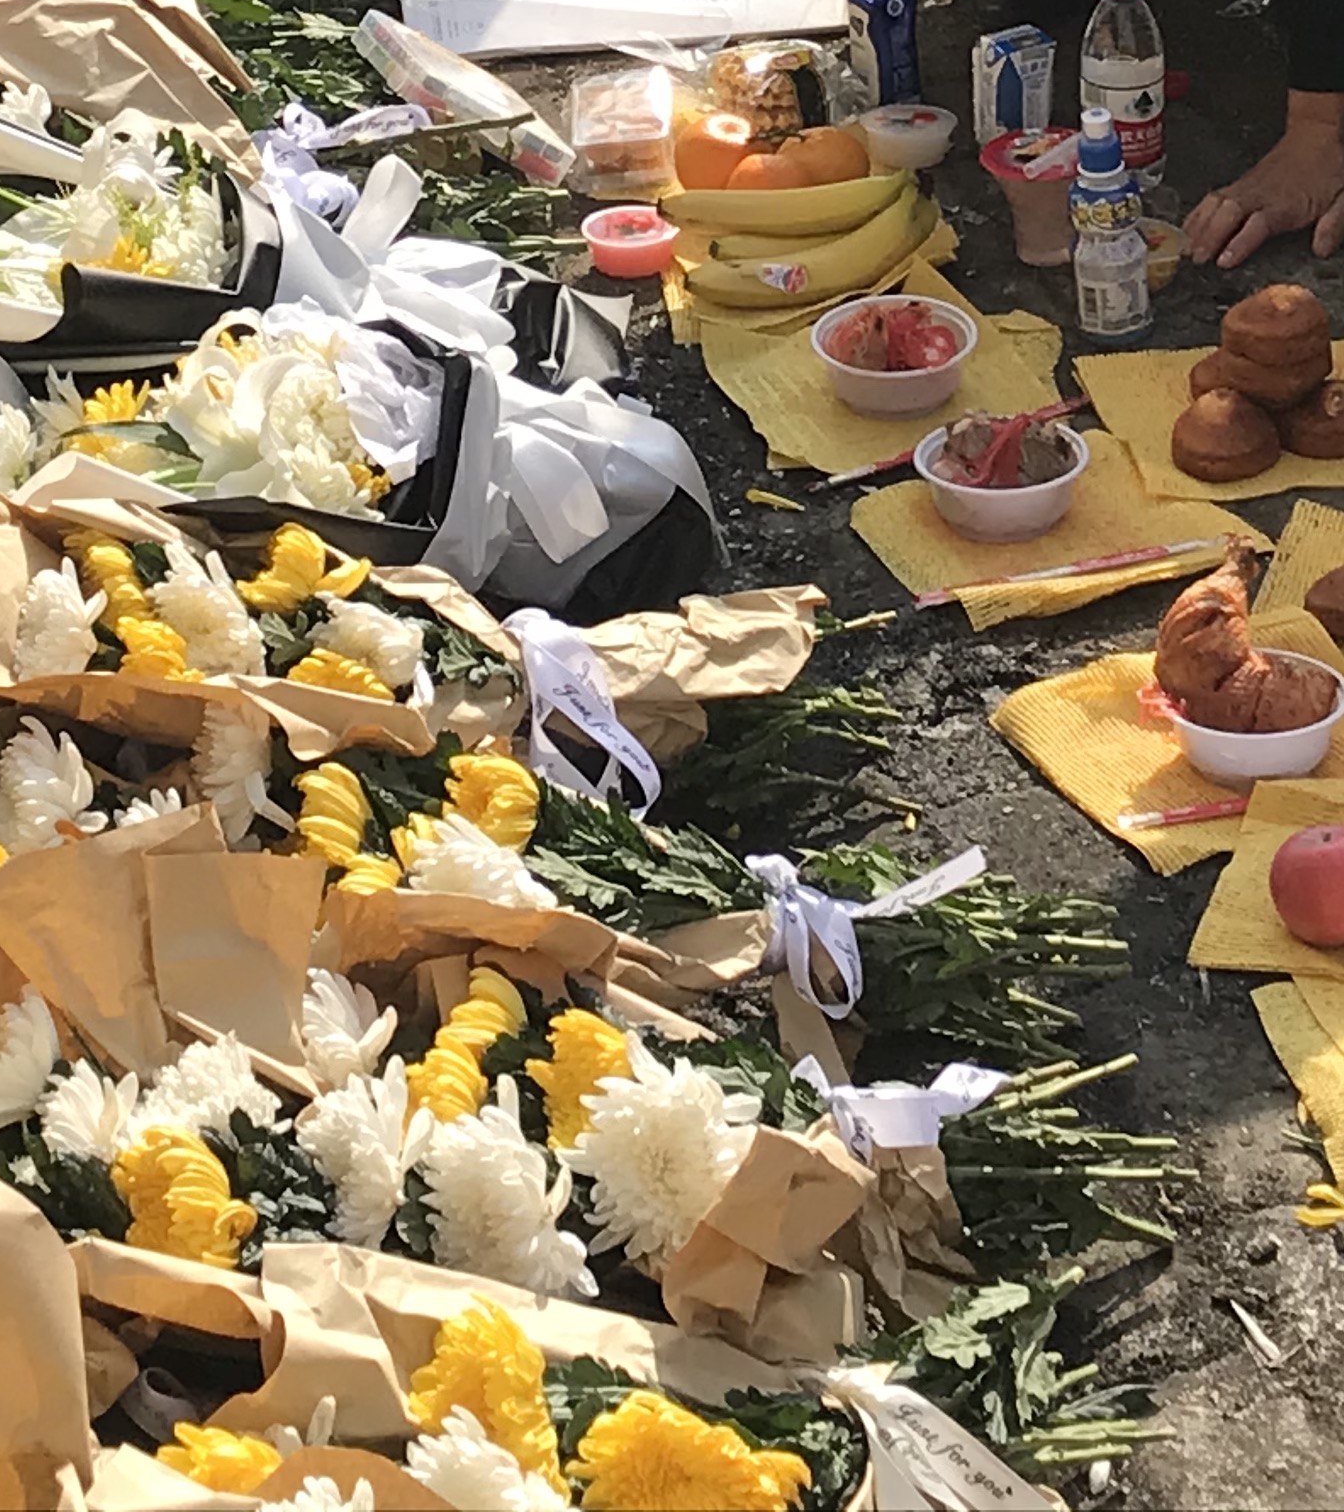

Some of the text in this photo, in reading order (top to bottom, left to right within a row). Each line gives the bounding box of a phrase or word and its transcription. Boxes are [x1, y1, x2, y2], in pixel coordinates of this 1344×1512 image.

[892, 1404, 939, 1453] Just
[932, 1443, 971, 1472] for
[965, 1470, 1007, 1500] you
